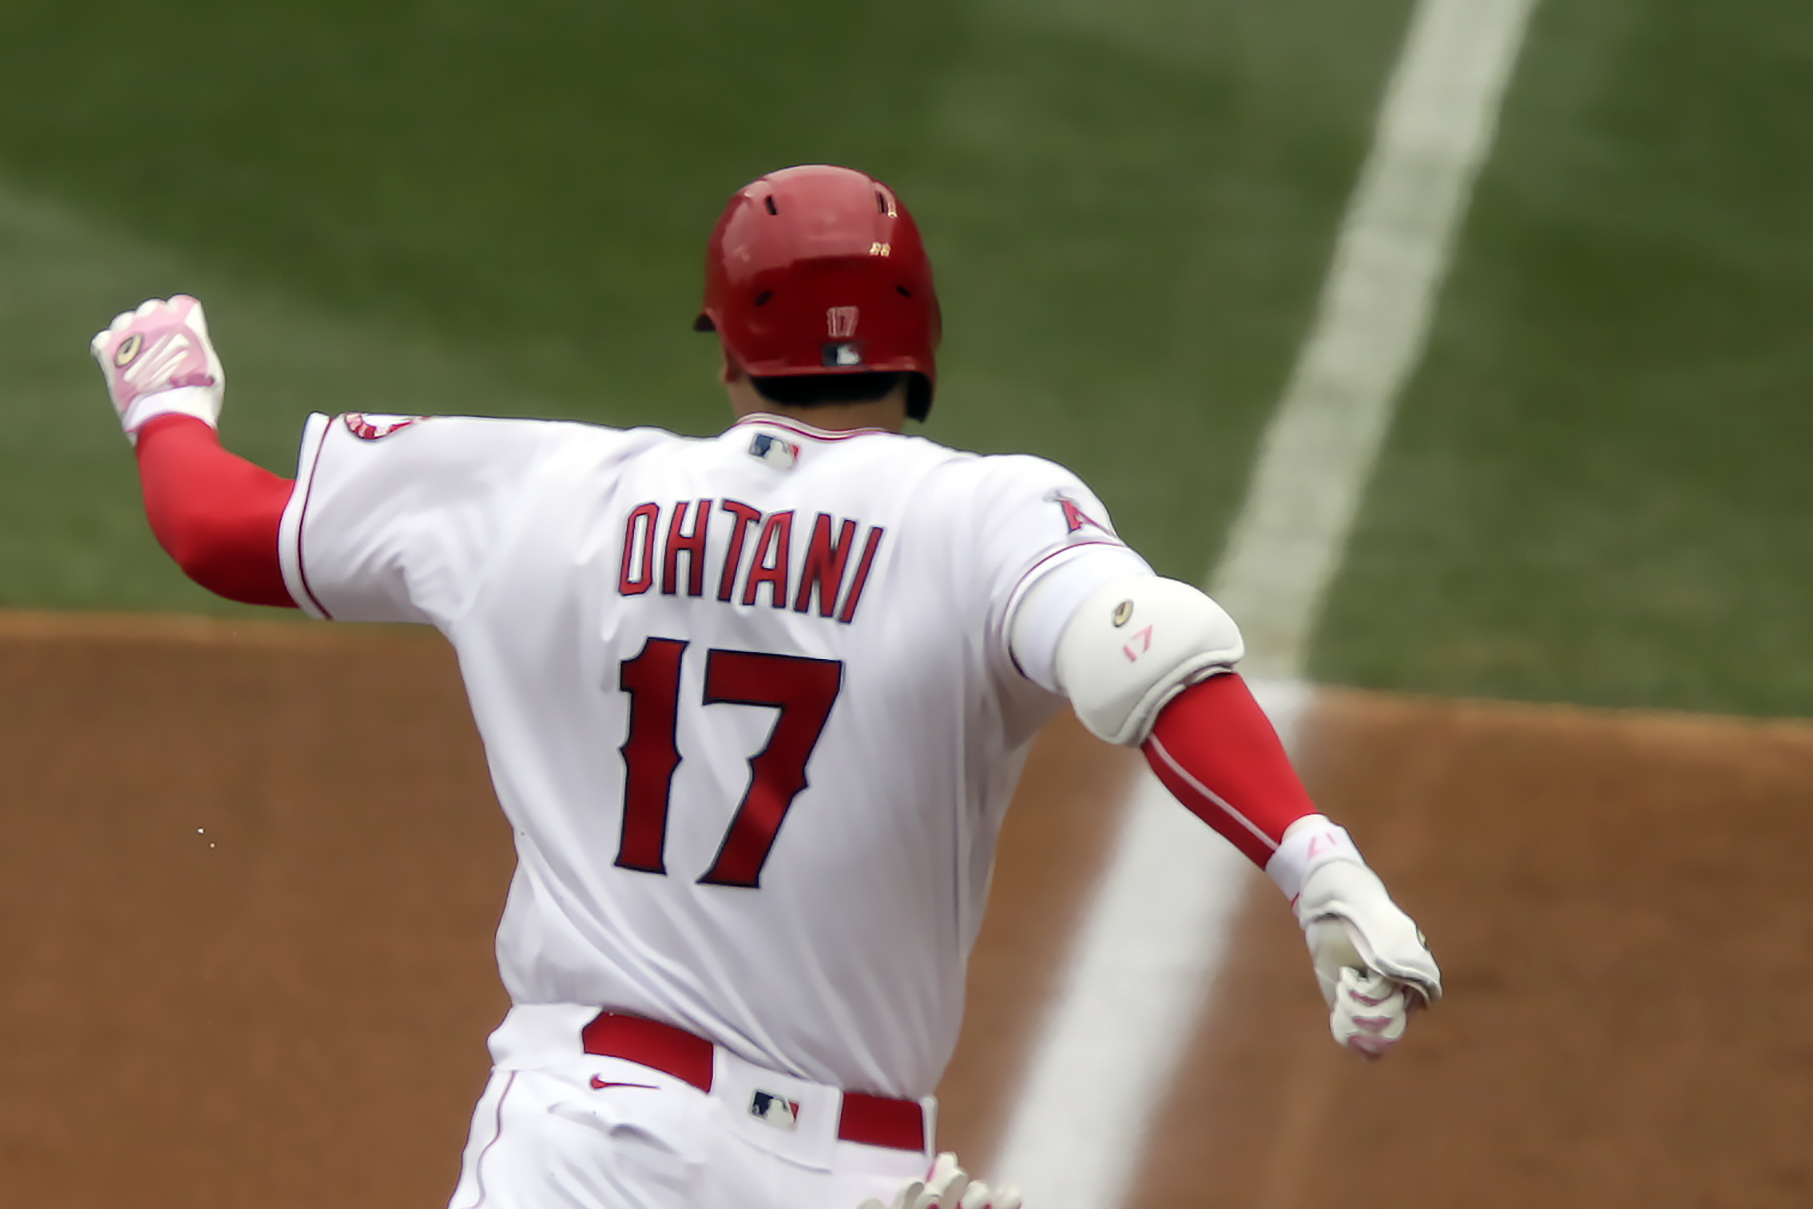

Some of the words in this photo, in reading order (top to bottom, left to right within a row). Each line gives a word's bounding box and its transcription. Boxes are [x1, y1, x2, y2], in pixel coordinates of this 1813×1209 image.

[618, 499, 884, 624] OHTANI
[1123, 624, 1154, 664] 17
[612, 636, 844, 888] 17
